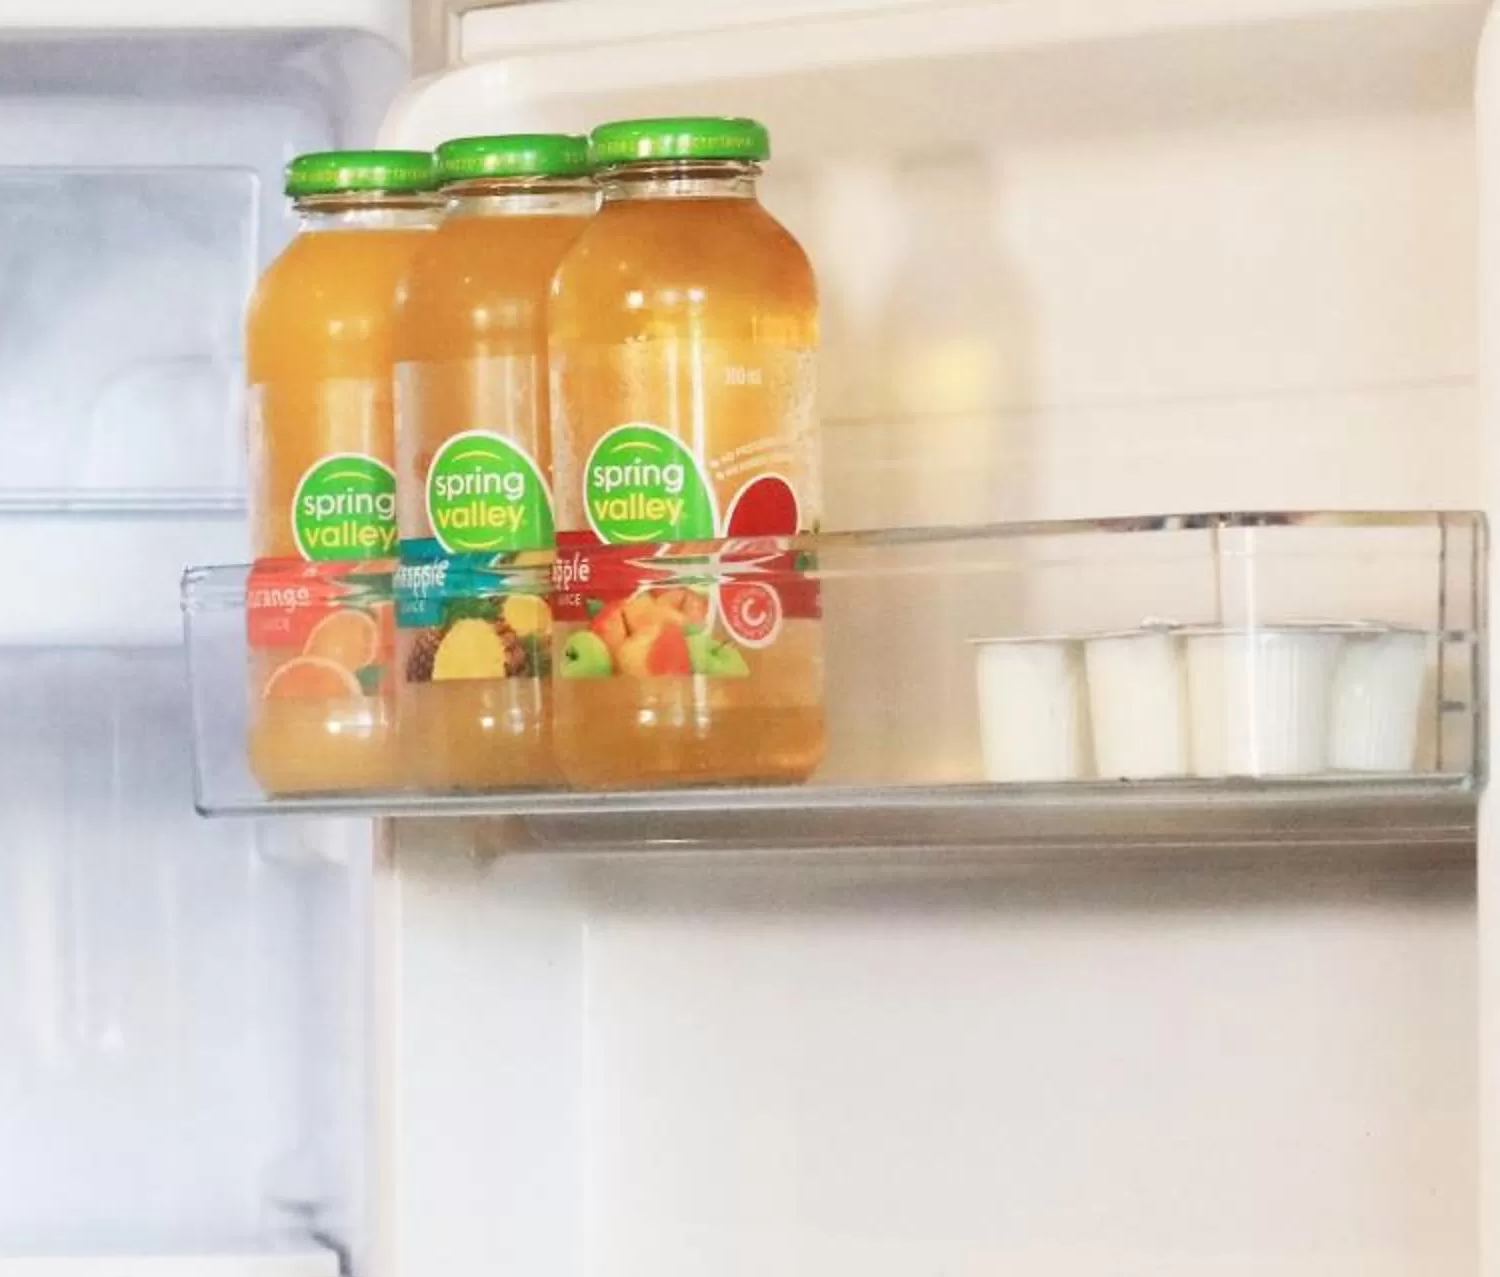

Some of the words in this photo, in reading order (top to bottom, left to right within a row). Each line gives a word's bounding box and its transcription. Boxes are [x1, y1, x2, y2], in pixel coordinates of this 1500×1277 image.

[435, 466, 525, 500] spring
[594, 457, 684, 493] spring
[304, 488, 396, 521] spring
[437, 500, 525, 534] valley
[594, 493, 684, 526] valley
[305, 520, 396, 551] valley
